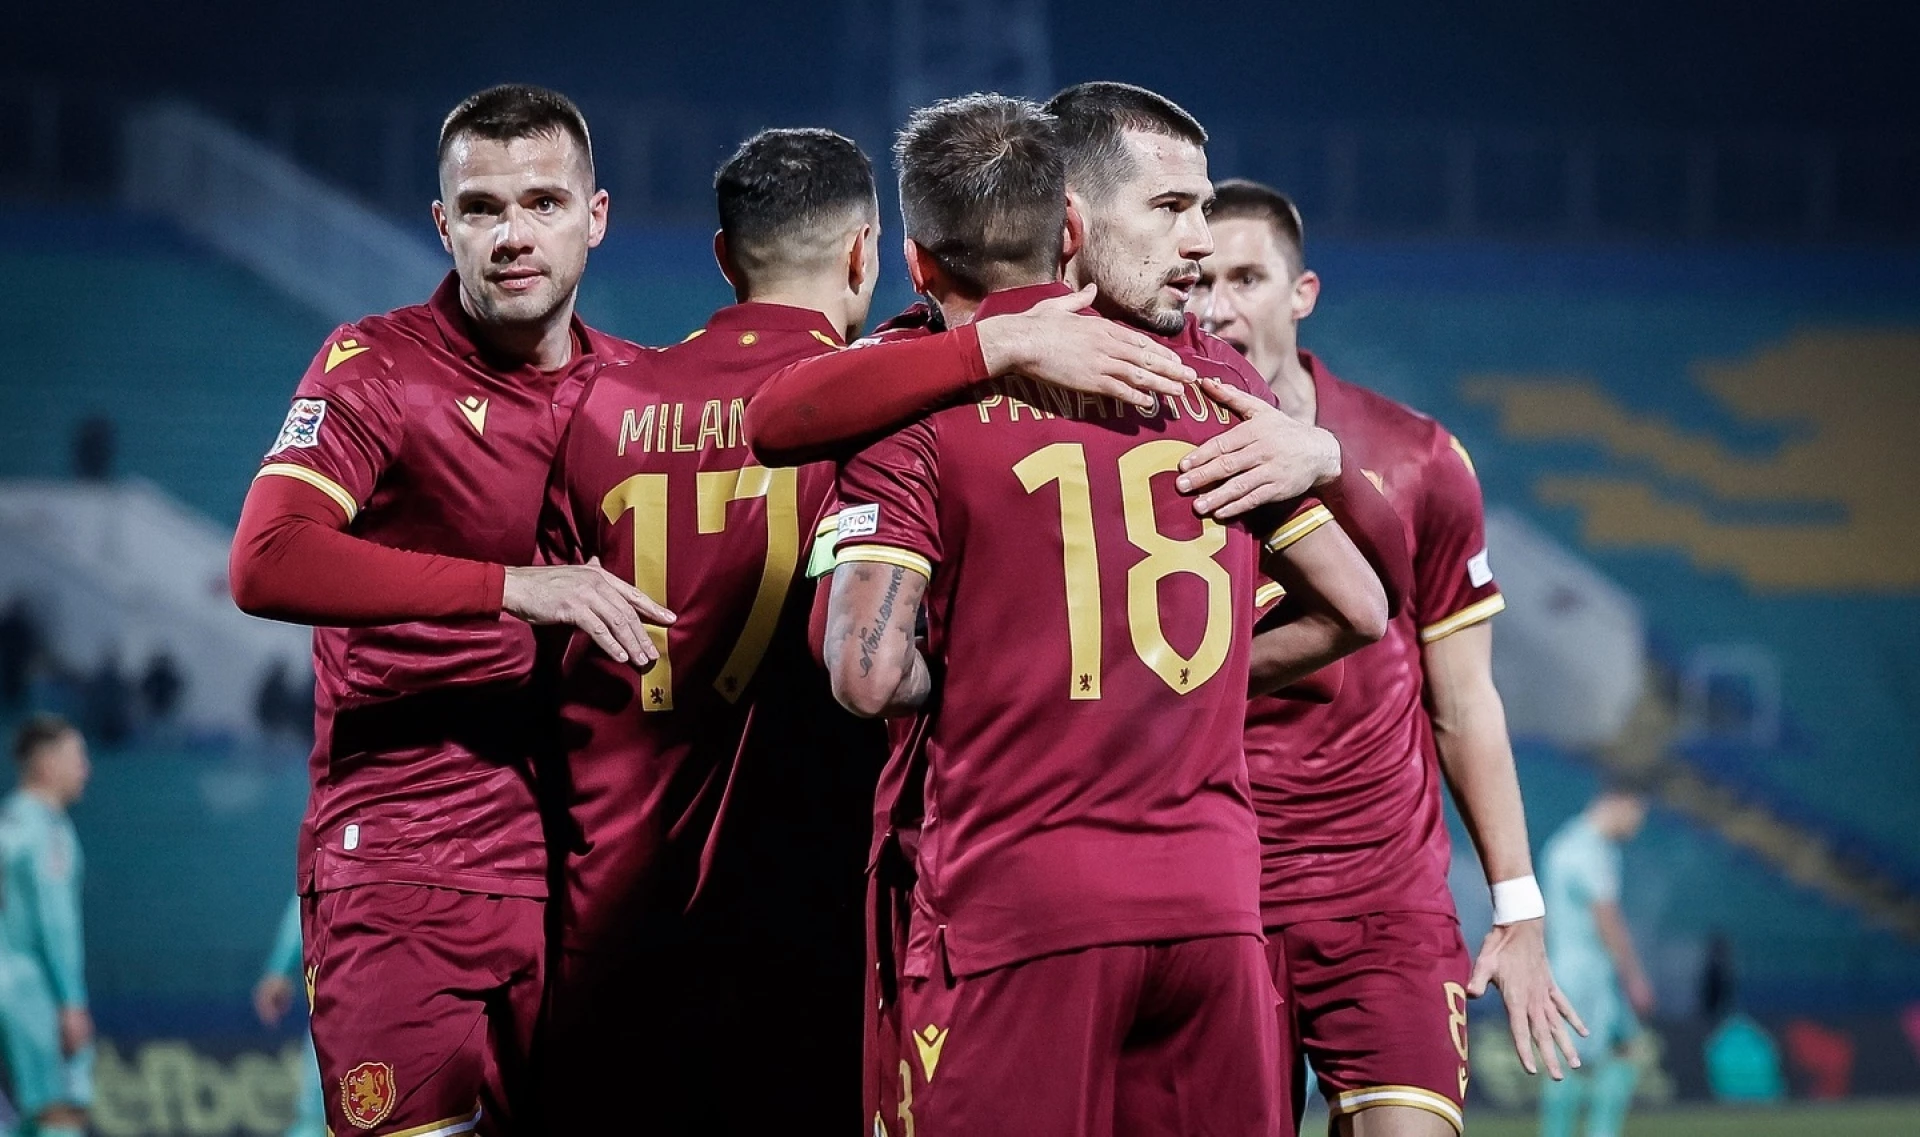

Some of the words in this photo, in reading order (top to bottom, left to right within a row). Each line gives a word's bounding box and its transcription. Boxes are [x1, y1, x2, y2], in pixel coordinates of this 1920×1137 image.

[617, 398, 748, 457] MILAN
[601, 466, 800, 711] 17
[840, 513, 876, 528] ATION
[1011, 439, 1233, 700] 18
